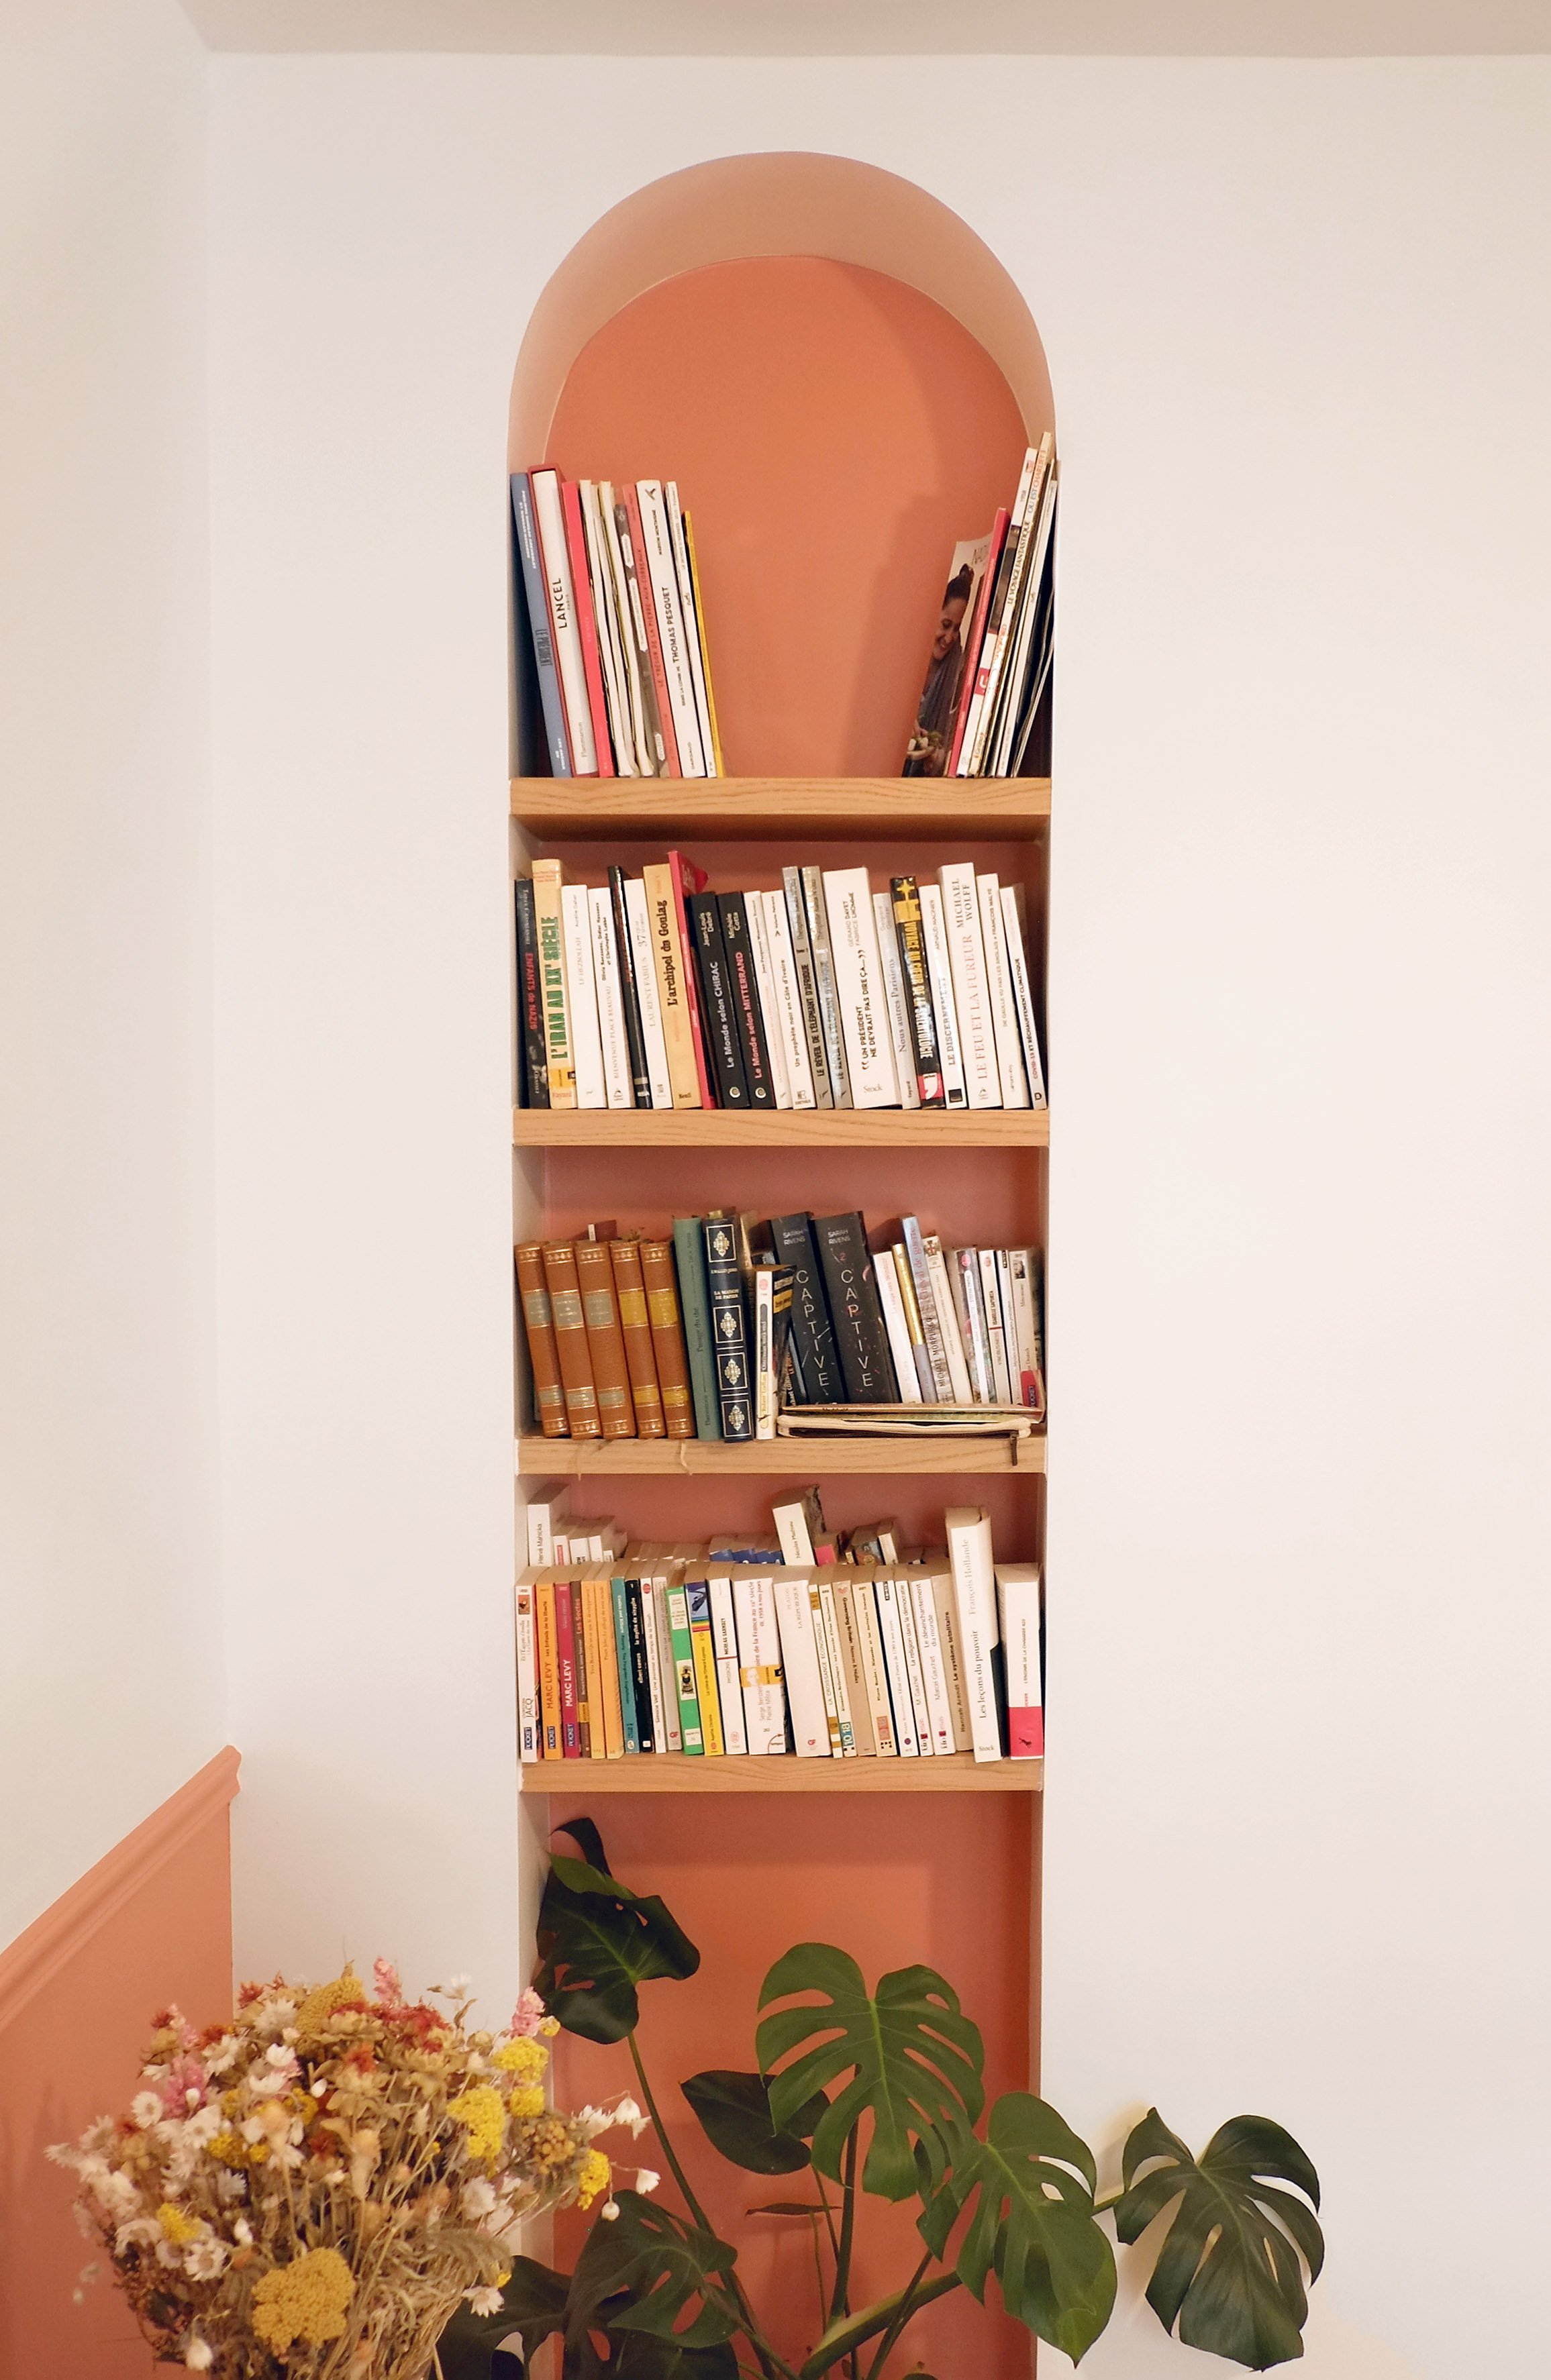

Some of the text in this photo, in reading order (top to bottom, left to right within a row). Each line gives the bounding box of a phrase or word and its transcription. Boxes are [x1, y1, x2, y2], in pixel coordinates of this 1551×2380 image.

[1007, 569, 1019, 596] VOYAGE
[1013, 520, 1030, 568] FANTASTIQUE
[552, 578, 567, 629] LANCEL
[661, 586, 674, 625] PESQUET
[667, 627, 679, 663] THOMAS
[842, 900, 850, 919] DAVET
[950, 877, 965, 928] MICHAEL
[960, 882, 974, 921] WOLFF
[654, 899, 670, 936] Goulag
[698, 912, 711, 947] Jean-Louis
[704, 911, 714, 933] Debré
[725, 912, 735, 939] Michèle
[732, 911, 741, 931] Cotta
[636, 933, 647, 948] 37
[659, 939, 670, 952] du
[903, 921, 919, 950] VOYAGE
[907, 950, 921, 962] AU
[525, 951, 538, 1030] ENFANTS de NAZIS
[640, 956, 656, 1027] LAURENT FABIUS
[660, 955, 679, 1006] L'archipel
[783, 986, 791, 1000] Côte
[801, 963, 812, 996] D'AFRIQUE
[860, 979, 868, 994] DIRE
[911, 984, 925, 996] DE
[546, 990, 564, 1008] AU
[604, 984, 613, 1016] BEAUVAU
[787, 1001, 792, 1009] en
[862, 996, 871, 1011] PAS
[885, 958, 907, 1053] Nous autres Parisiens
[960, 934, 988, 1079] LE FEU ET LA FUREUR
[709, 961, 734, 1068] Le Monde selon CHIRAC
[734, 951, 762, 1078] Le Monde selon MITTERRAND
[787, 1011, 795, 1025] noir
[1013, 957, 1038, 1079] COVID-19 ET RÉCHAUFFEMENT CLIMATIQUE
[548, 1013, 567, 1059] L'IRAN
[789, 1027, 799, 1055] prophète
[811, 1034, 819, 1043] DE
[854, 1004, 868, 1058] UN PRÉSIDENT
[864, 1013, 875, 1045] DEVRAIT
[610, 1040, 619, 1078] BIENVENUE
[794, 1057, 801, 1067] Un
[869, 1047, 877, 1057] NE
[947, 1054, 956, 1066] LE
[783, 1229, 803, 1239] SARAH
[784, 1237, 805, 1246] RIVENS
[828, 1229, 849, 1238] SARAH
[828, 1236, 851, 1245] RIVENS
[913, 1257, 923, 1269] de
[915, 1272, 929, 1300] Cheval
[796, 1270, 830, 1387] CAPTIVE
[840, 1270, 873, 1387] CAPTIVE
[925, 1316, 940, 1355] MORPURGO
[934, 1358, 946, 1387] MICHAEL
[960, 1539, 977, 1615] François Hollande
[750, 1608, 756, 1616] au
[842, 1596, 852, 1626] Governing
[899, 1584, 908, 1616] démocratie
[750, 1618, 758, 1637] France
[797, 1620, 803, 1629] LA
[915, 1582, 929, 1648] Le désenchantement
[846, 1625, 854, 1643] Britain
[903, 1623, 911, 1637] dans
[927, 1614, 936, 1647] du monde
[905, 1637, 916, 1658] religion
[909, 1658, 915, 1666] La
[944, 1610, 965, 1732] Hannah Arendt Le système totalitaire
[970, 1629, 987, 1718] Les leçons du pouvoir
[562, 1658, 573, 1707] MARC LEVY
[821, 1661, 831, 1696] CROISSANCE
[928, 1655, 940, 1700] Marcel Gauchet
[524, 1698, 534, 1718] JACQ
[545, 1684, 553, 1708] MARC
[828, 1697, 833, 1705] LA
[566, 1722, 574, 1746] POCKET
[840, 1722, 851, 1745] 10 18
